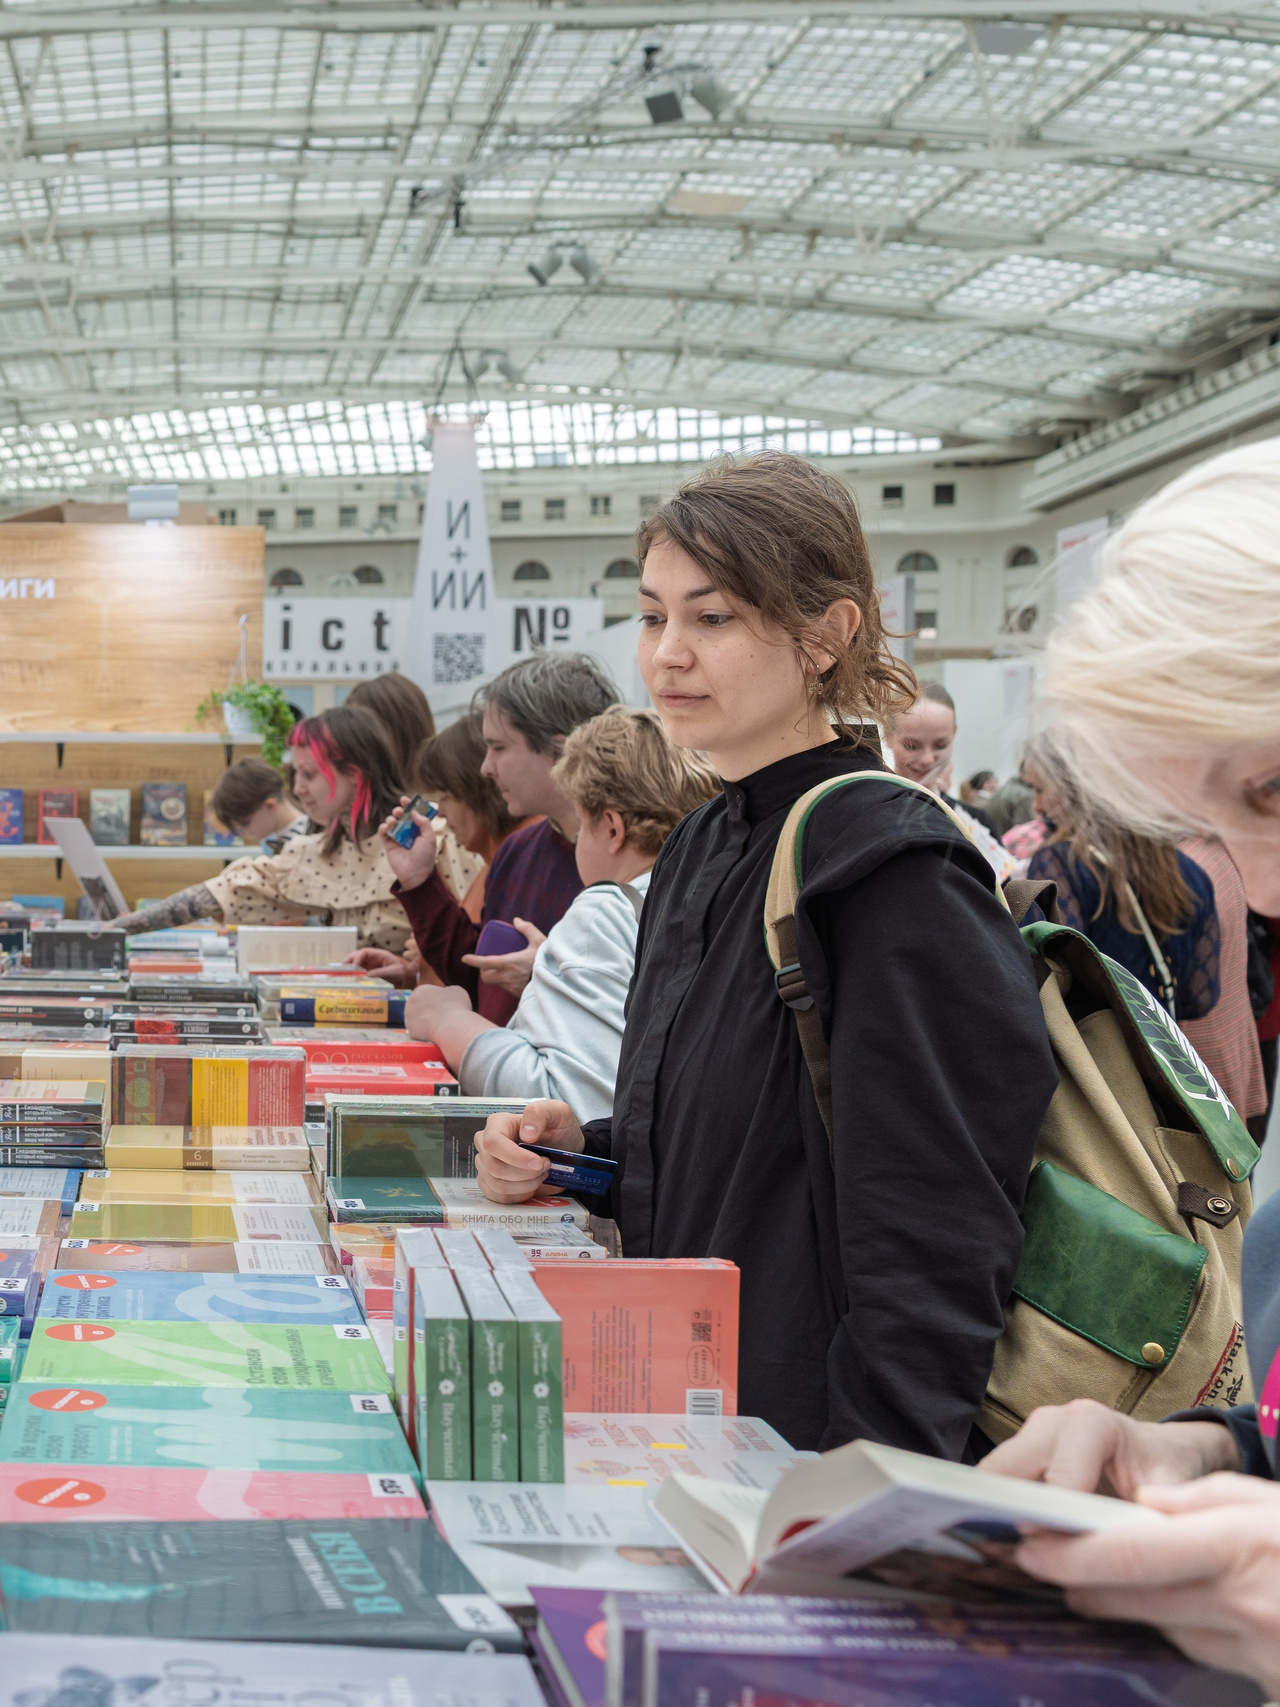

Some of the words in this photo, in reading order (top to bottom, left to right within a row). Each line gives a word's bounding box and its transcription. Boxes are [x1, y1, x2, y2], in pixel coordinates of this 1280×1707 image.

[446, 499, 471, 540] И
[194, 1151, 202, 1161] 6
[461, 1214, 495, 1224] КНИГА
[498, 1214, 523, 1224] ОБО
[527, 1215, 549, 1225] МНЕ
[323, 1277, 342, 1288] 550
[286, 1328, 312, 1386] эмоциональные
[1220, 1320, 1244, 1377] Attack
[245, 1348, 266, 1385] Останови
[271, 1366, 289, 1385] свои
[315, 1359, 336, 1386] качели
[1207, 1379, 1224, 1399] on
[71, 1423, 98, 1460] тревогу
[309, 1531, 388, 1593] СЕБЯ
